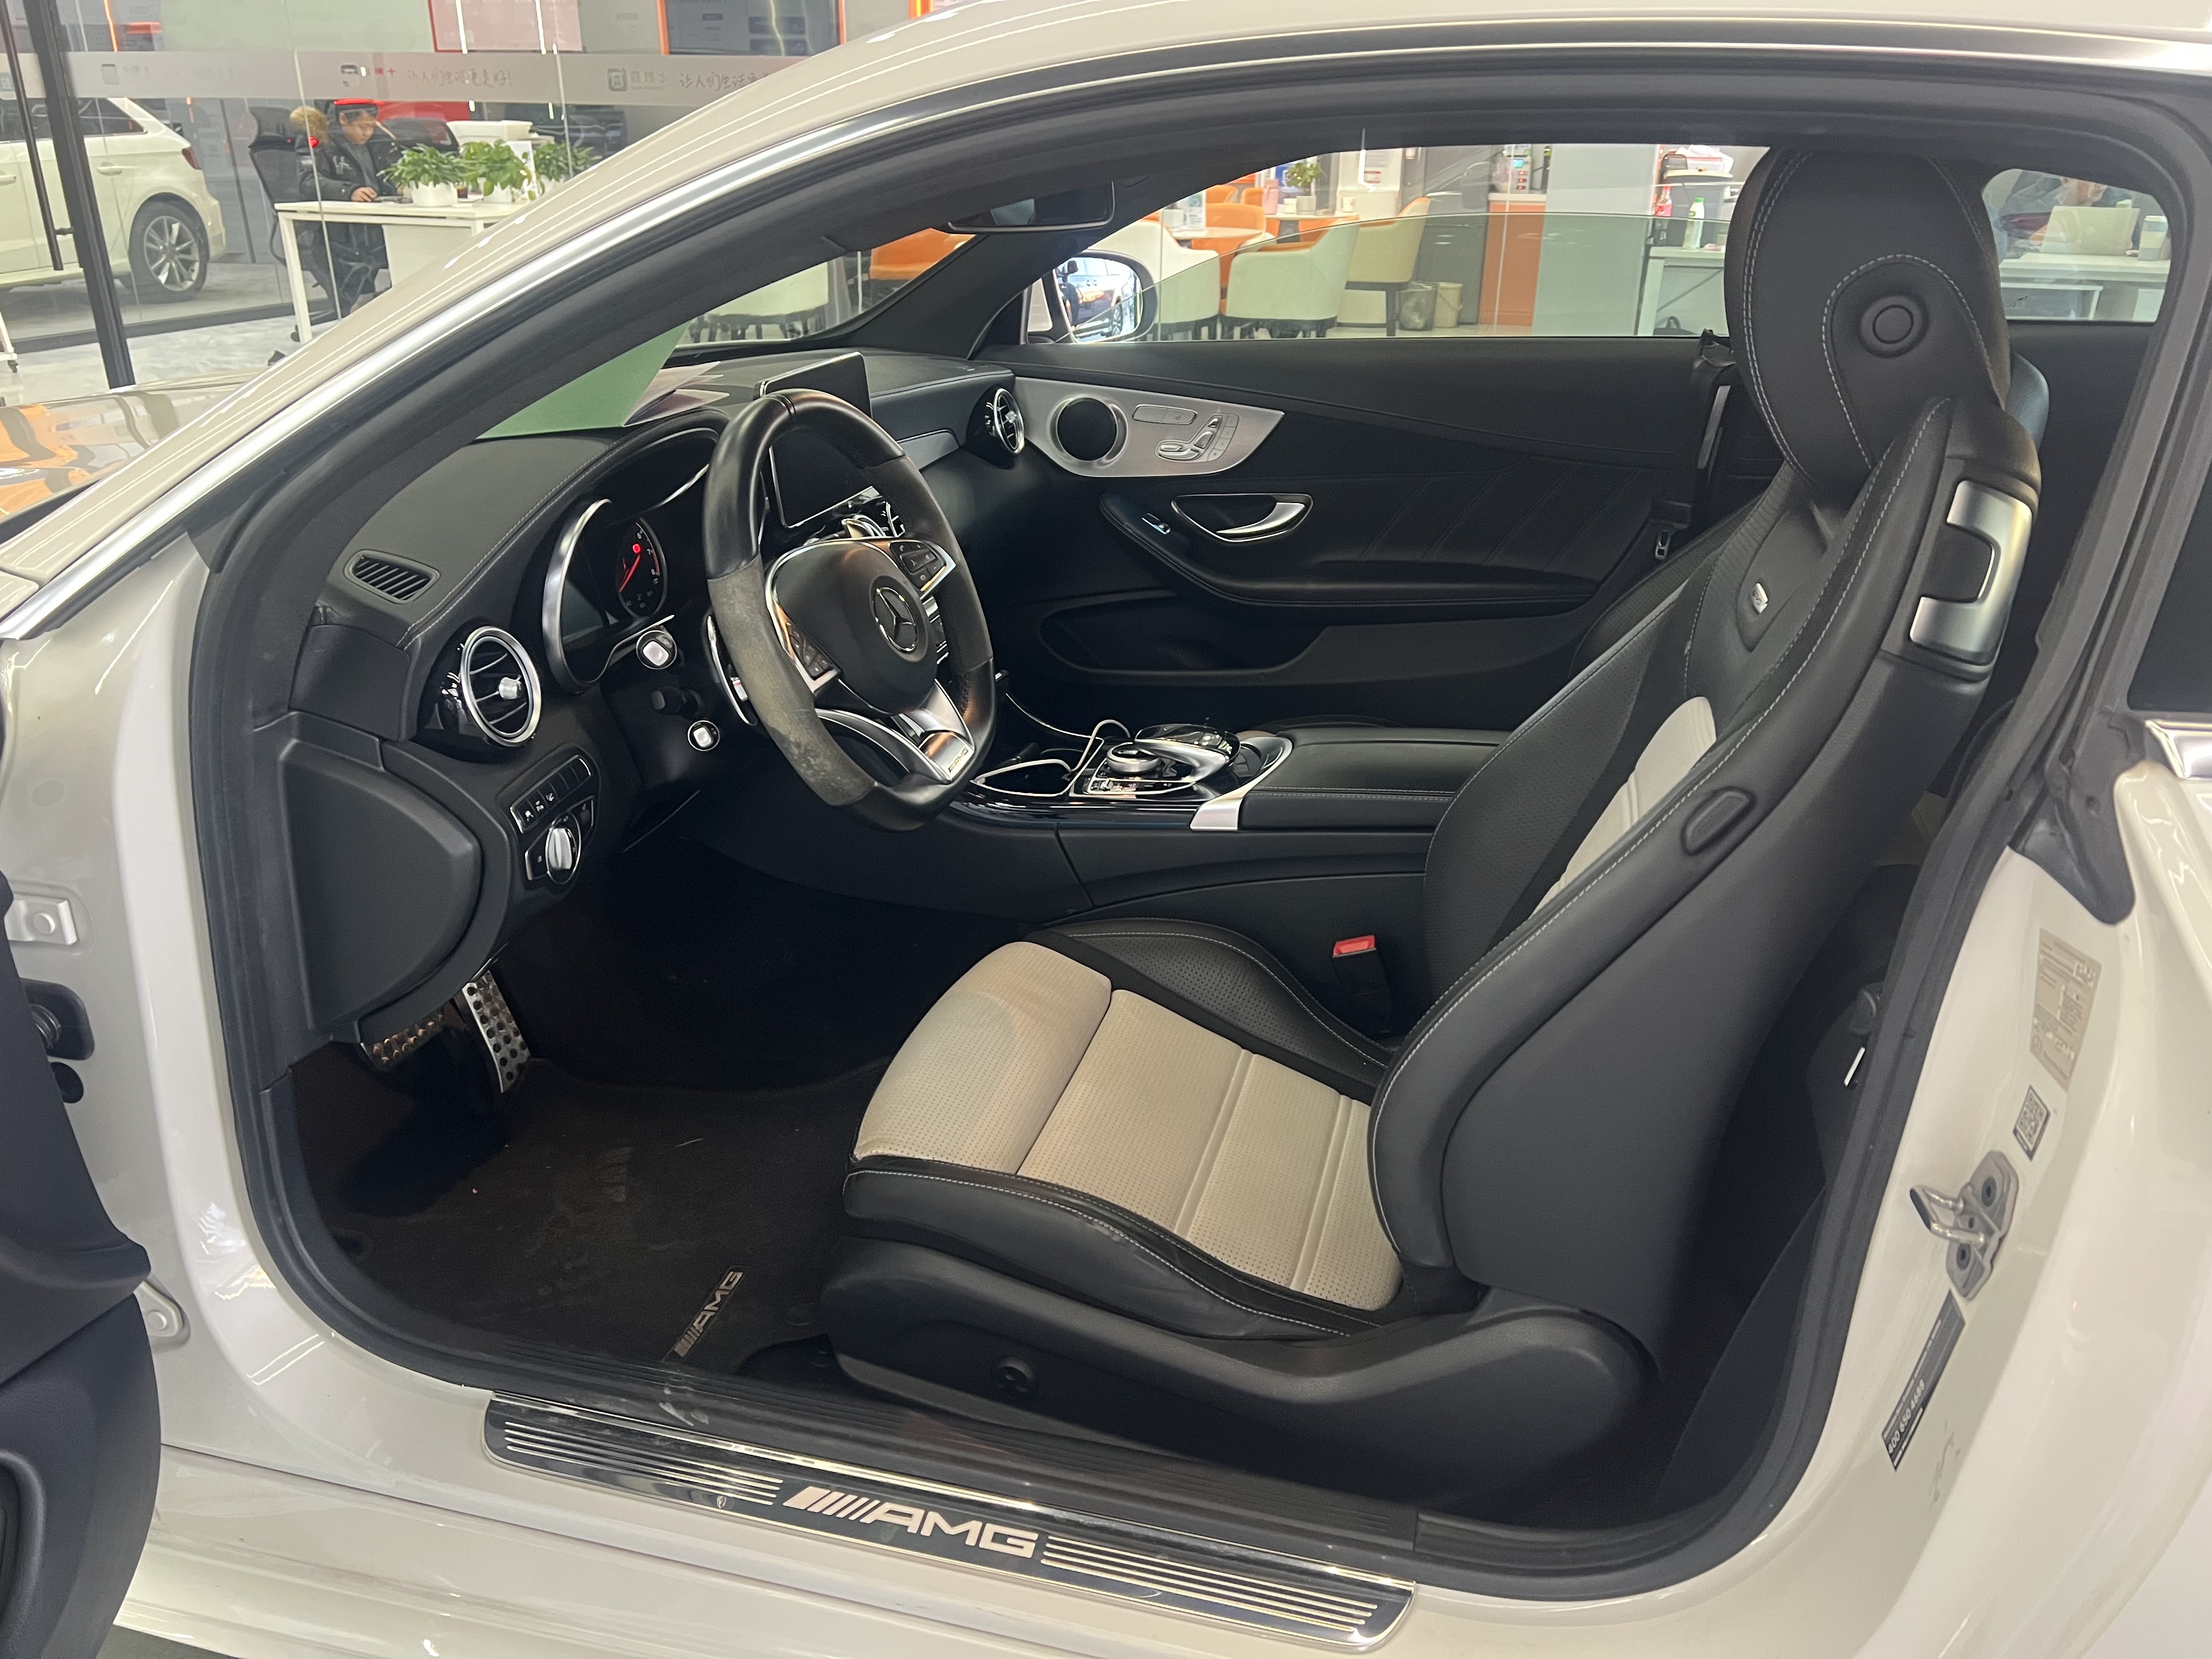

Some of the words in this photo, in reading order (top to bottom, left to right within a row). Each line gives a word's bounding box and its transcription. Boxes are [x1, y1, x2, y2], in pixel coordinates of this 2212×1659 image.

[954, 747, 969, 767] AMG
[693, 1271, 743, 1333] AMG
[859, 1502, 1039, 1559] AMG
